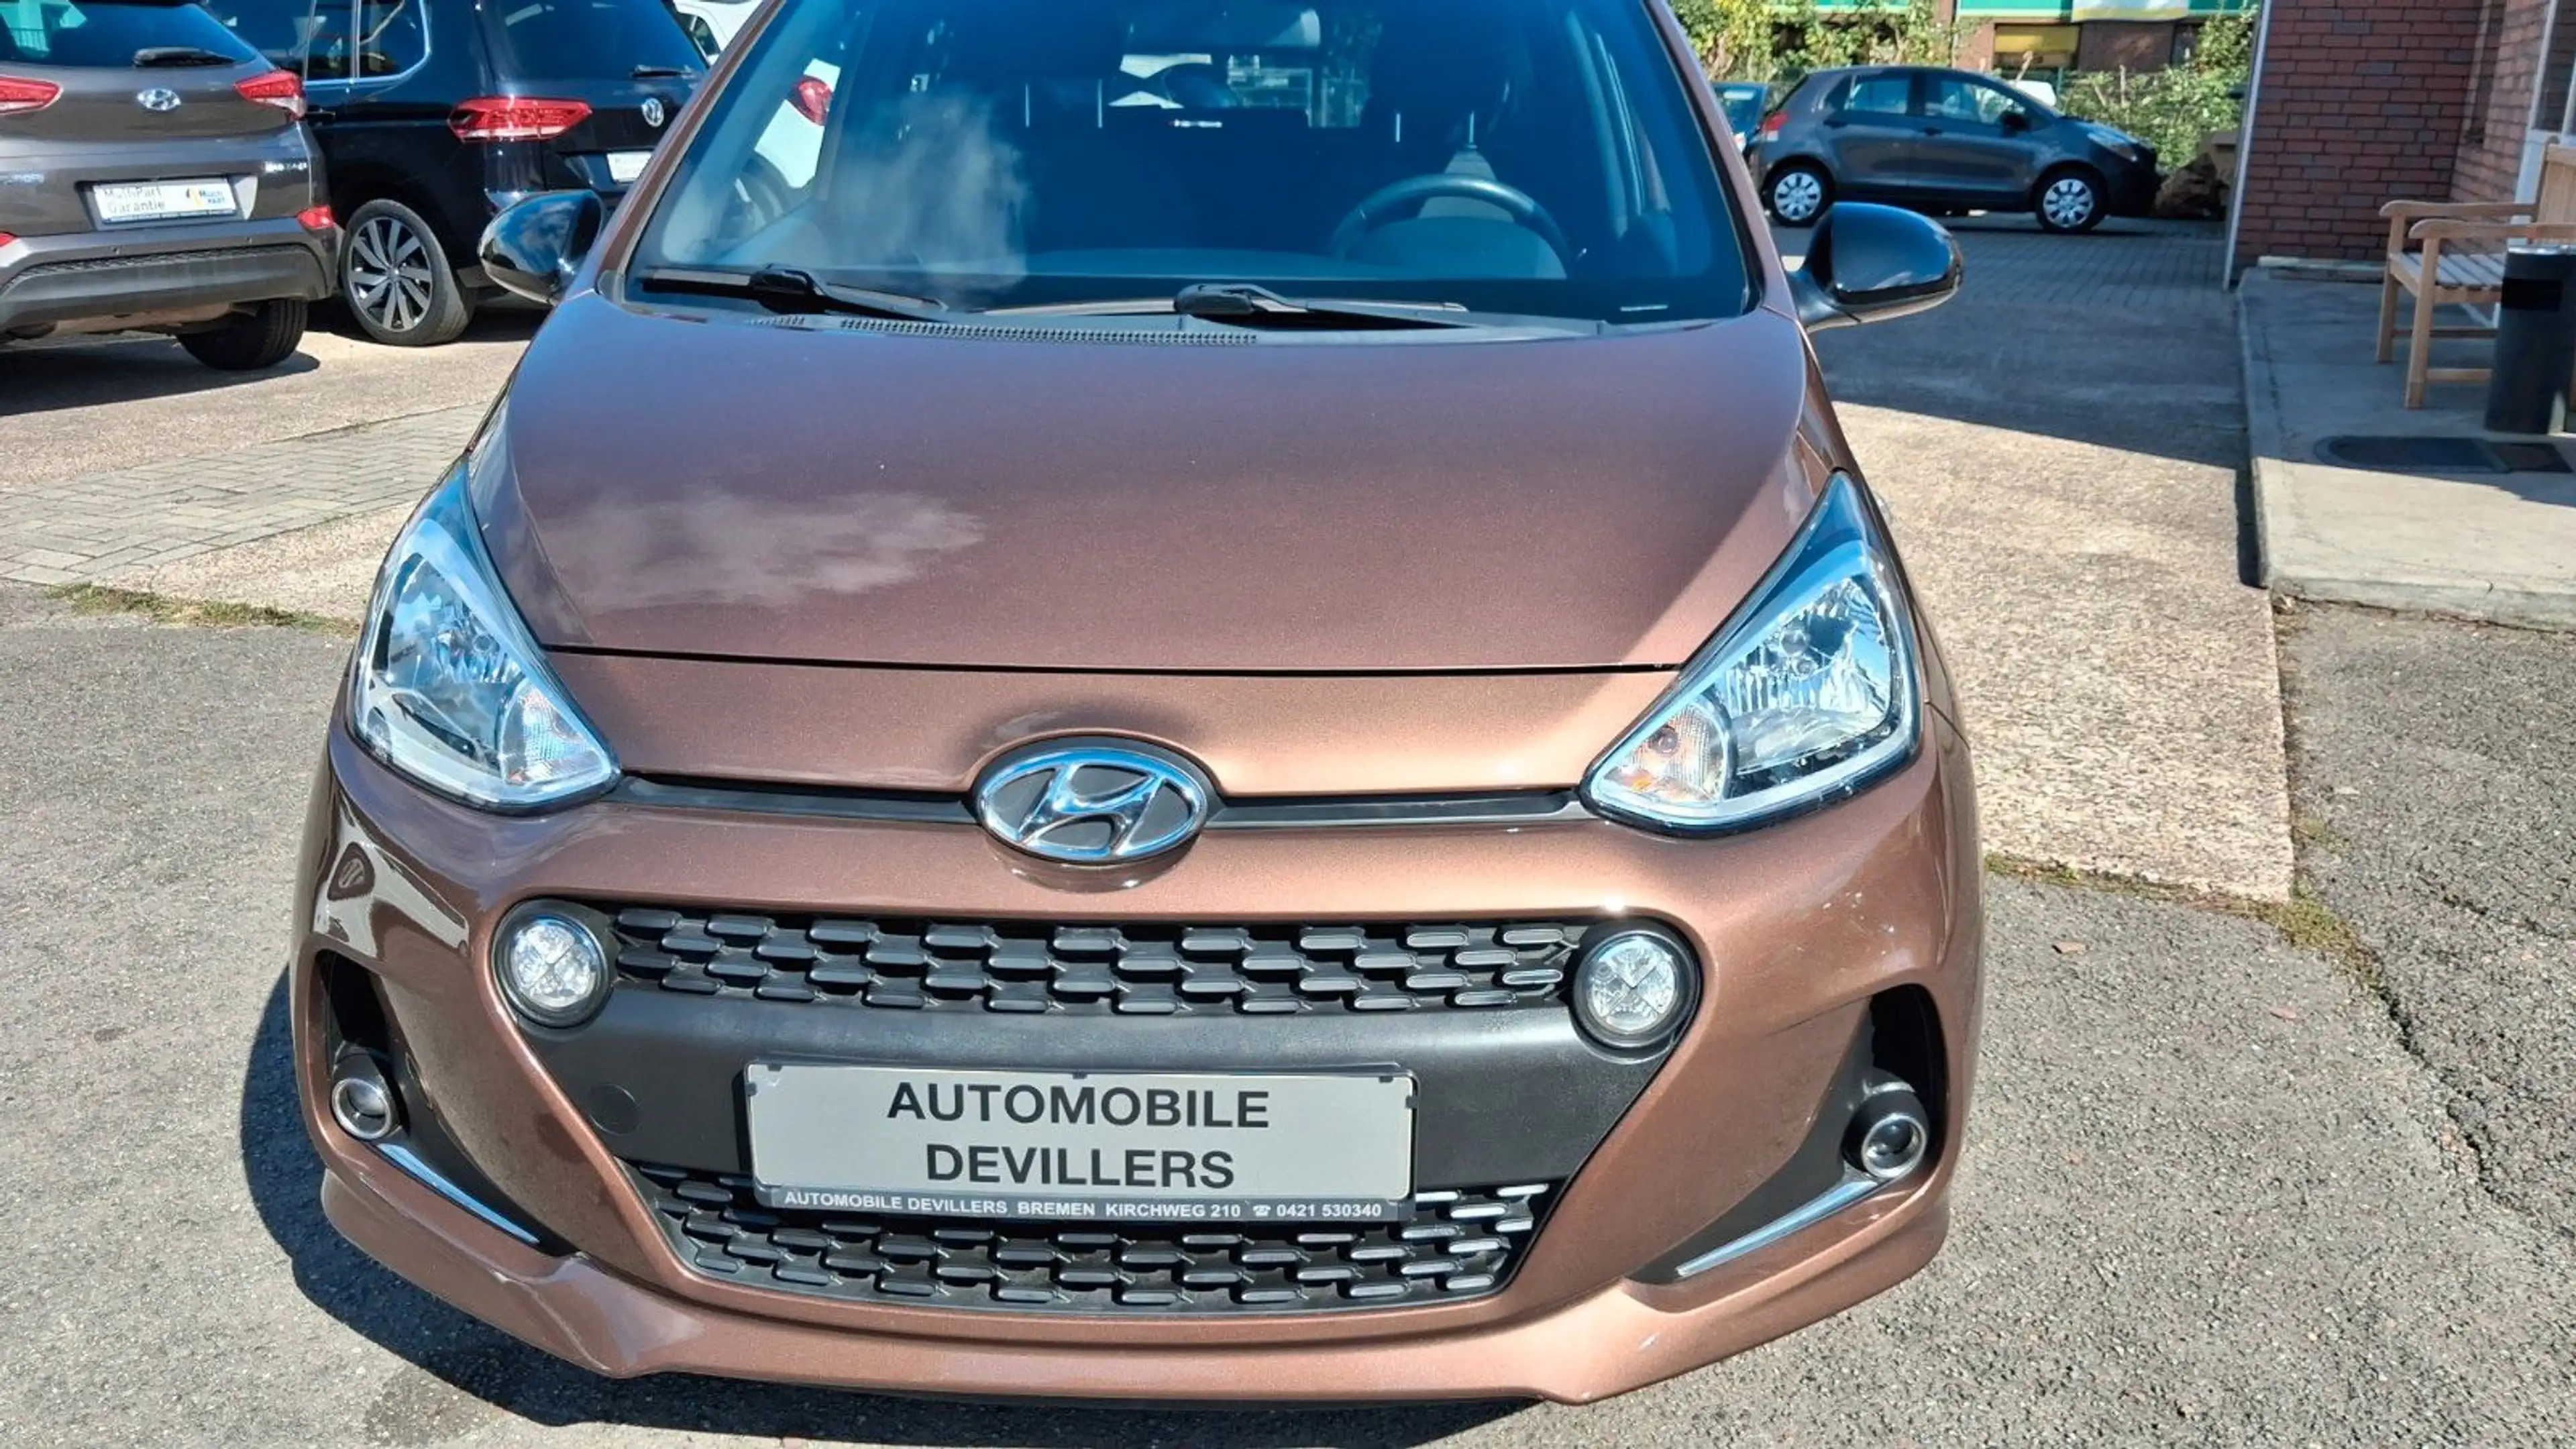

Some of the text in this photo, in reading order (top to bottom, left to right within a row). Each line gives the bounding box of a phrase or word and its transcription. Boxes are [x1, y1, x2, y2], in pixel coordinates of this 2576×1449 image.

[107, 200, 165, 213] Garantie
[887, 1081, 1270, 1128] AUTOMOBILE
[926, 1143, 1234, 1189] DEVILLERS
[784, 1190, 1382, 1218] AUTOMOBILE DEVILLERS BREMEN KIRCHWEG 210 0421 530340
